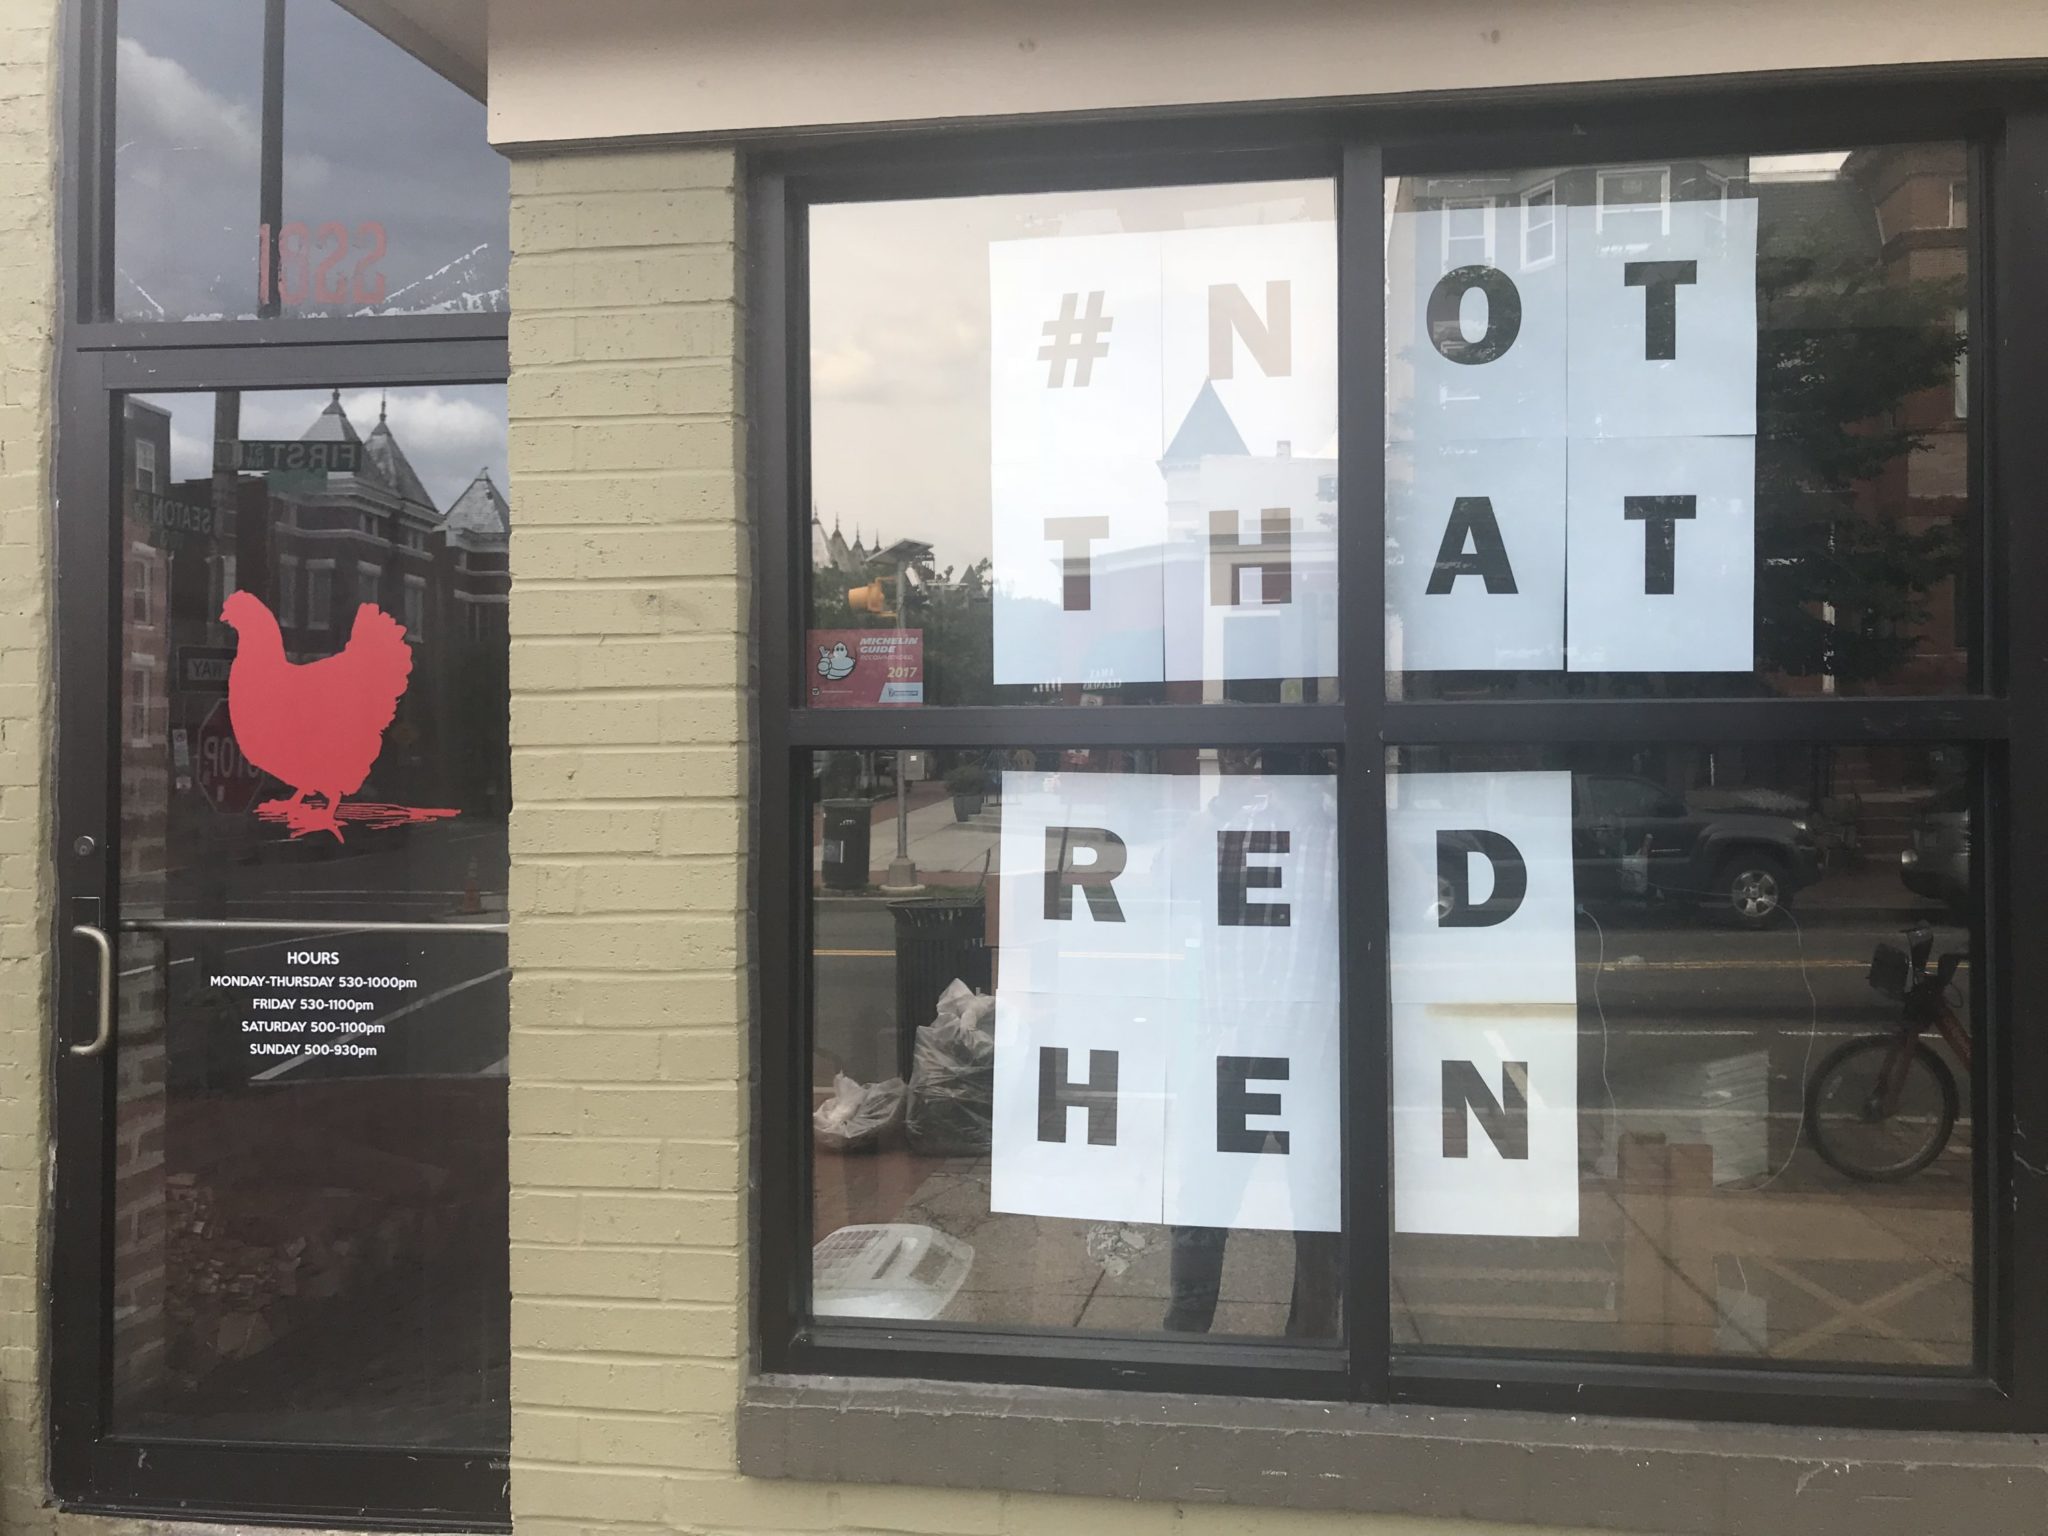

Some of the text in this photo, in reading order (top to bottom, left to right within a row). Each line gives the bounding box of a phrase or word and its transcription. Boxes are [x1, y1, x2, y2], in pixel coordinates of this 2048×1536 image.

[259, 220, 387, 305] 1822
[1037, 260, 1697, 389] #NOT
[1043, 495, 1697, 612] THAT
[859, 637, 919, 645] MICHELIN
[859, 645, 896, 653] GUIDE
[887, 666, 917, 678] 2017
[1043, 826, 1528, 928] RED
[287, 951, 340, 965] HOURS
[210, 975, 417, 990] MONDAY-THURSDAY 530-1000pm
[252, 998, 374, 1013] FRIDAY 530-1100pm
[241, 1021, 385, 1036] SATURDAY 500-1100pm
[250, 1043, 377, 1058] SUNDAY 500-930pm
[1037, 1046, 1529, 1160] HEN
